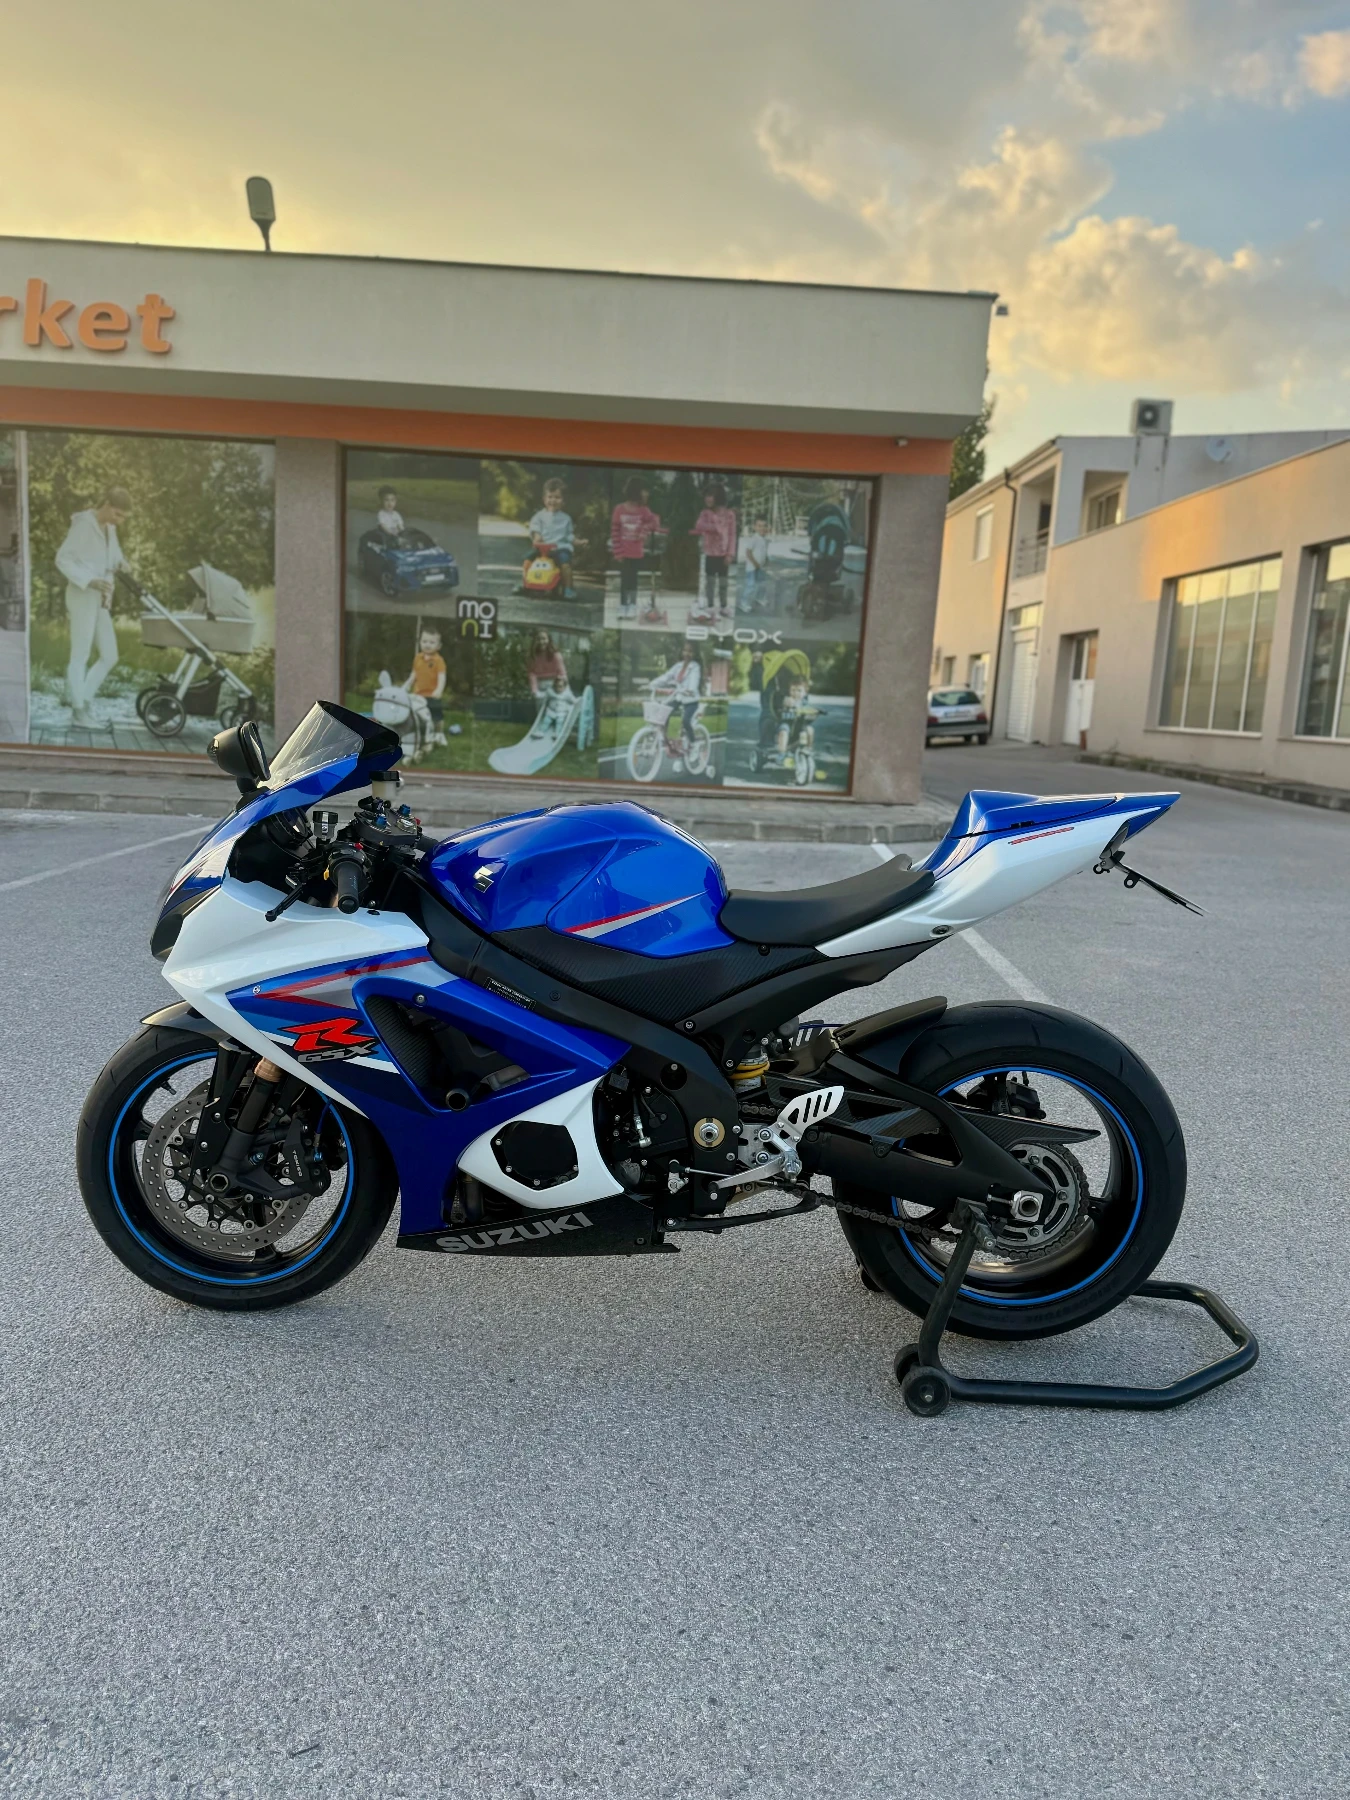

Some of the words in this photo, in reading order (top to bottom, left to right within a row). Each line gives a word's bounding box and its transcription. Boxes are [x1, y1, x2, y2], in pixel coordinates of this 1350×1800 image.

[685, 625, 783, 645] BYOX
[280, 1016, 376, 1052] R
[297, 1041, 376, 1063] GSX
[436, 1211, 594, 1253] SUZUKI
